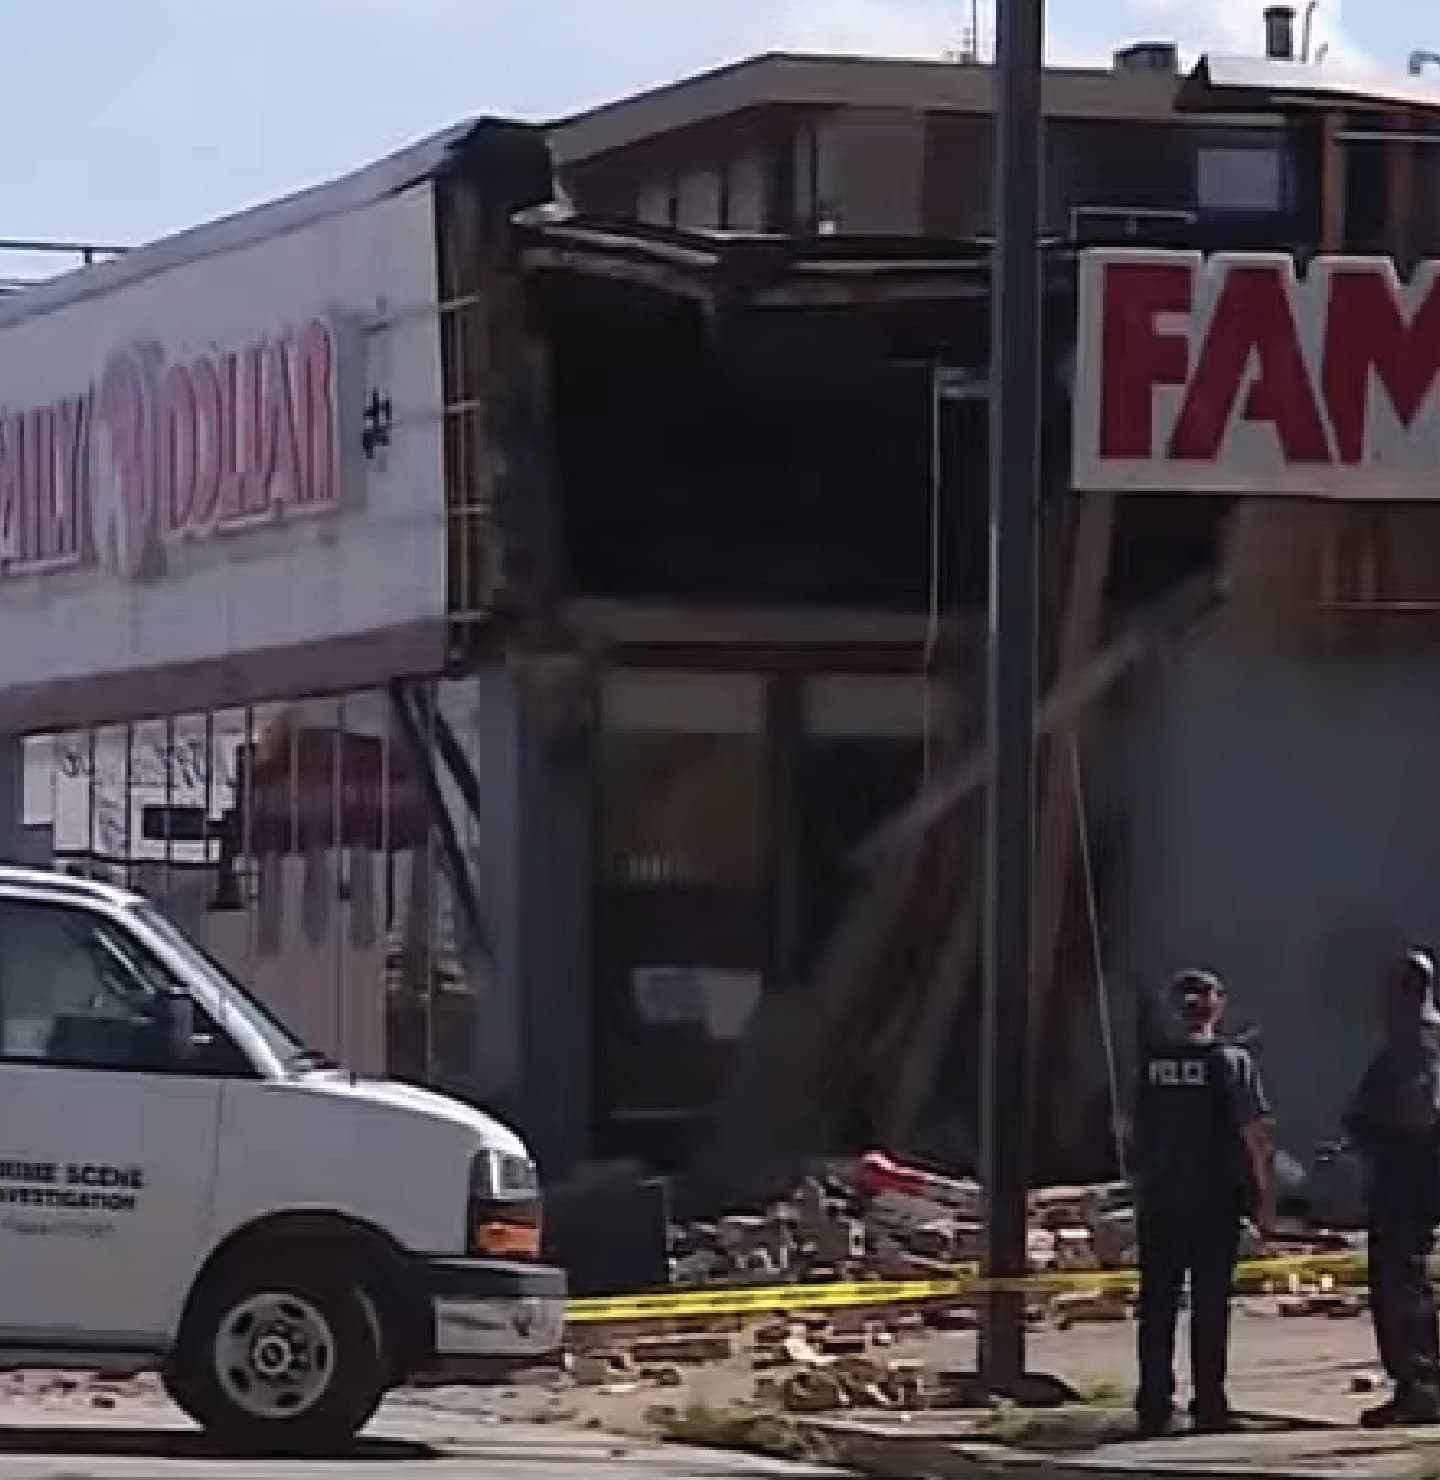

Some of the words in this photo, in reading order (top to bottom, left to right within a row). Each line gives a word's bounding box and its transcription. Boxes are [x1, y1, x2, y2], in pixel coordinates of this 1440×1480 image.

[164, 318, 334, 534] DOLLAR
[1147, 1059, 1208, 1086] POLICE
[66, 1163, 144, 1189] SCENE
